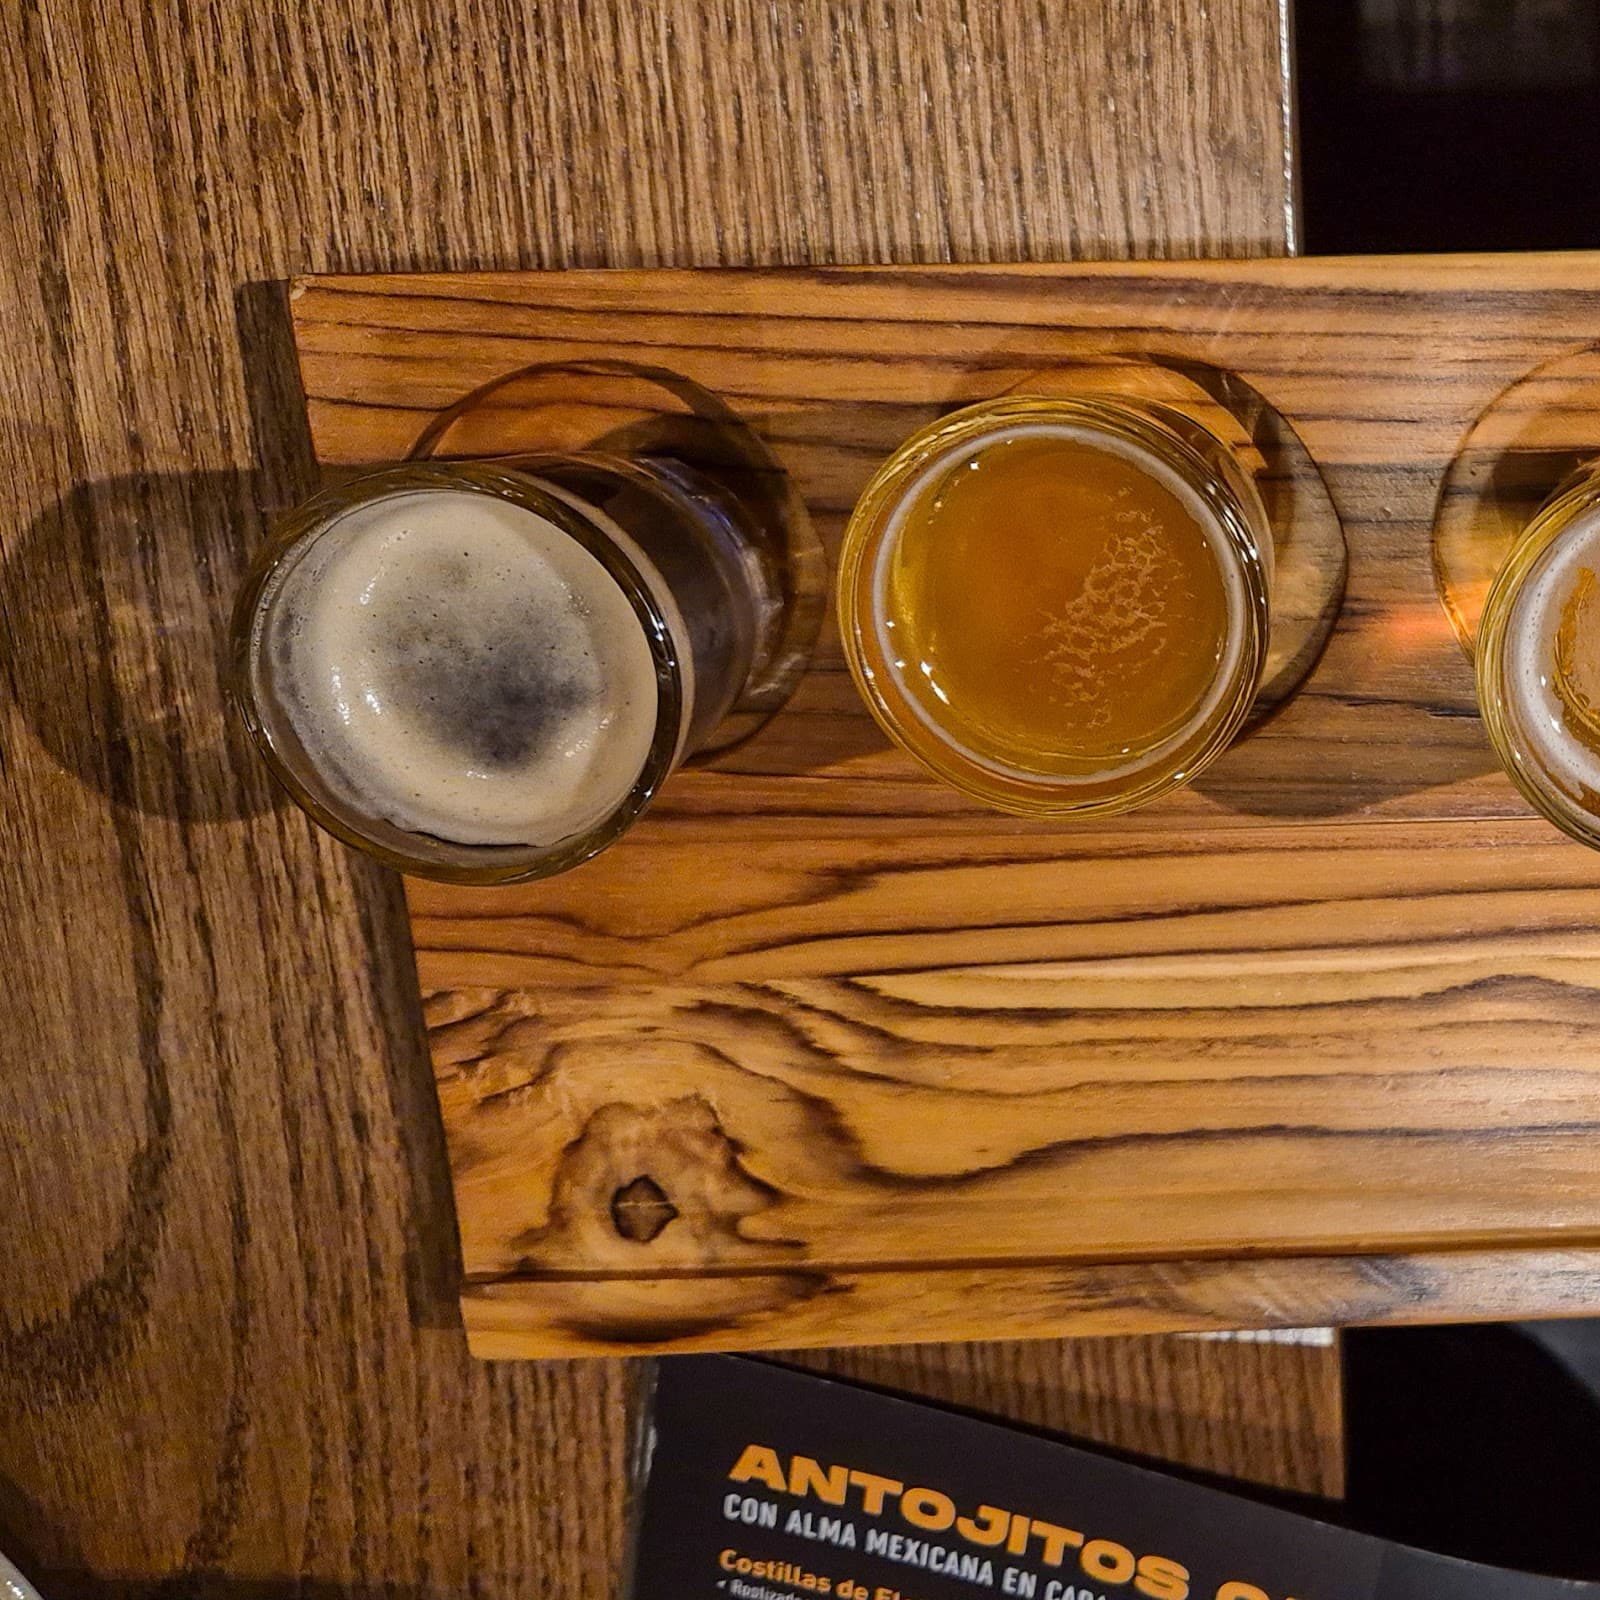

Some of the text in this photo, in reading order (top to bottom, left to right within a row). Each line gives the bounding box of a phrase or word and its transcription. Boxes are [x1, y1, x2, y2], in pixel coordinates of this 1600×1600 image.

[719, 1549, 832, 1593] Costillas
[835, 1579, 869, 1600] de
[723, 1493, 778, 1529] CON
[784, 1509, 857, 1549] ALMA
[864, 1528, 995, 1587] MEXICANA
[1001, 1566, 1038, 1600] EN
[728, 1444, 1190, 1600] ANTOJITOS
